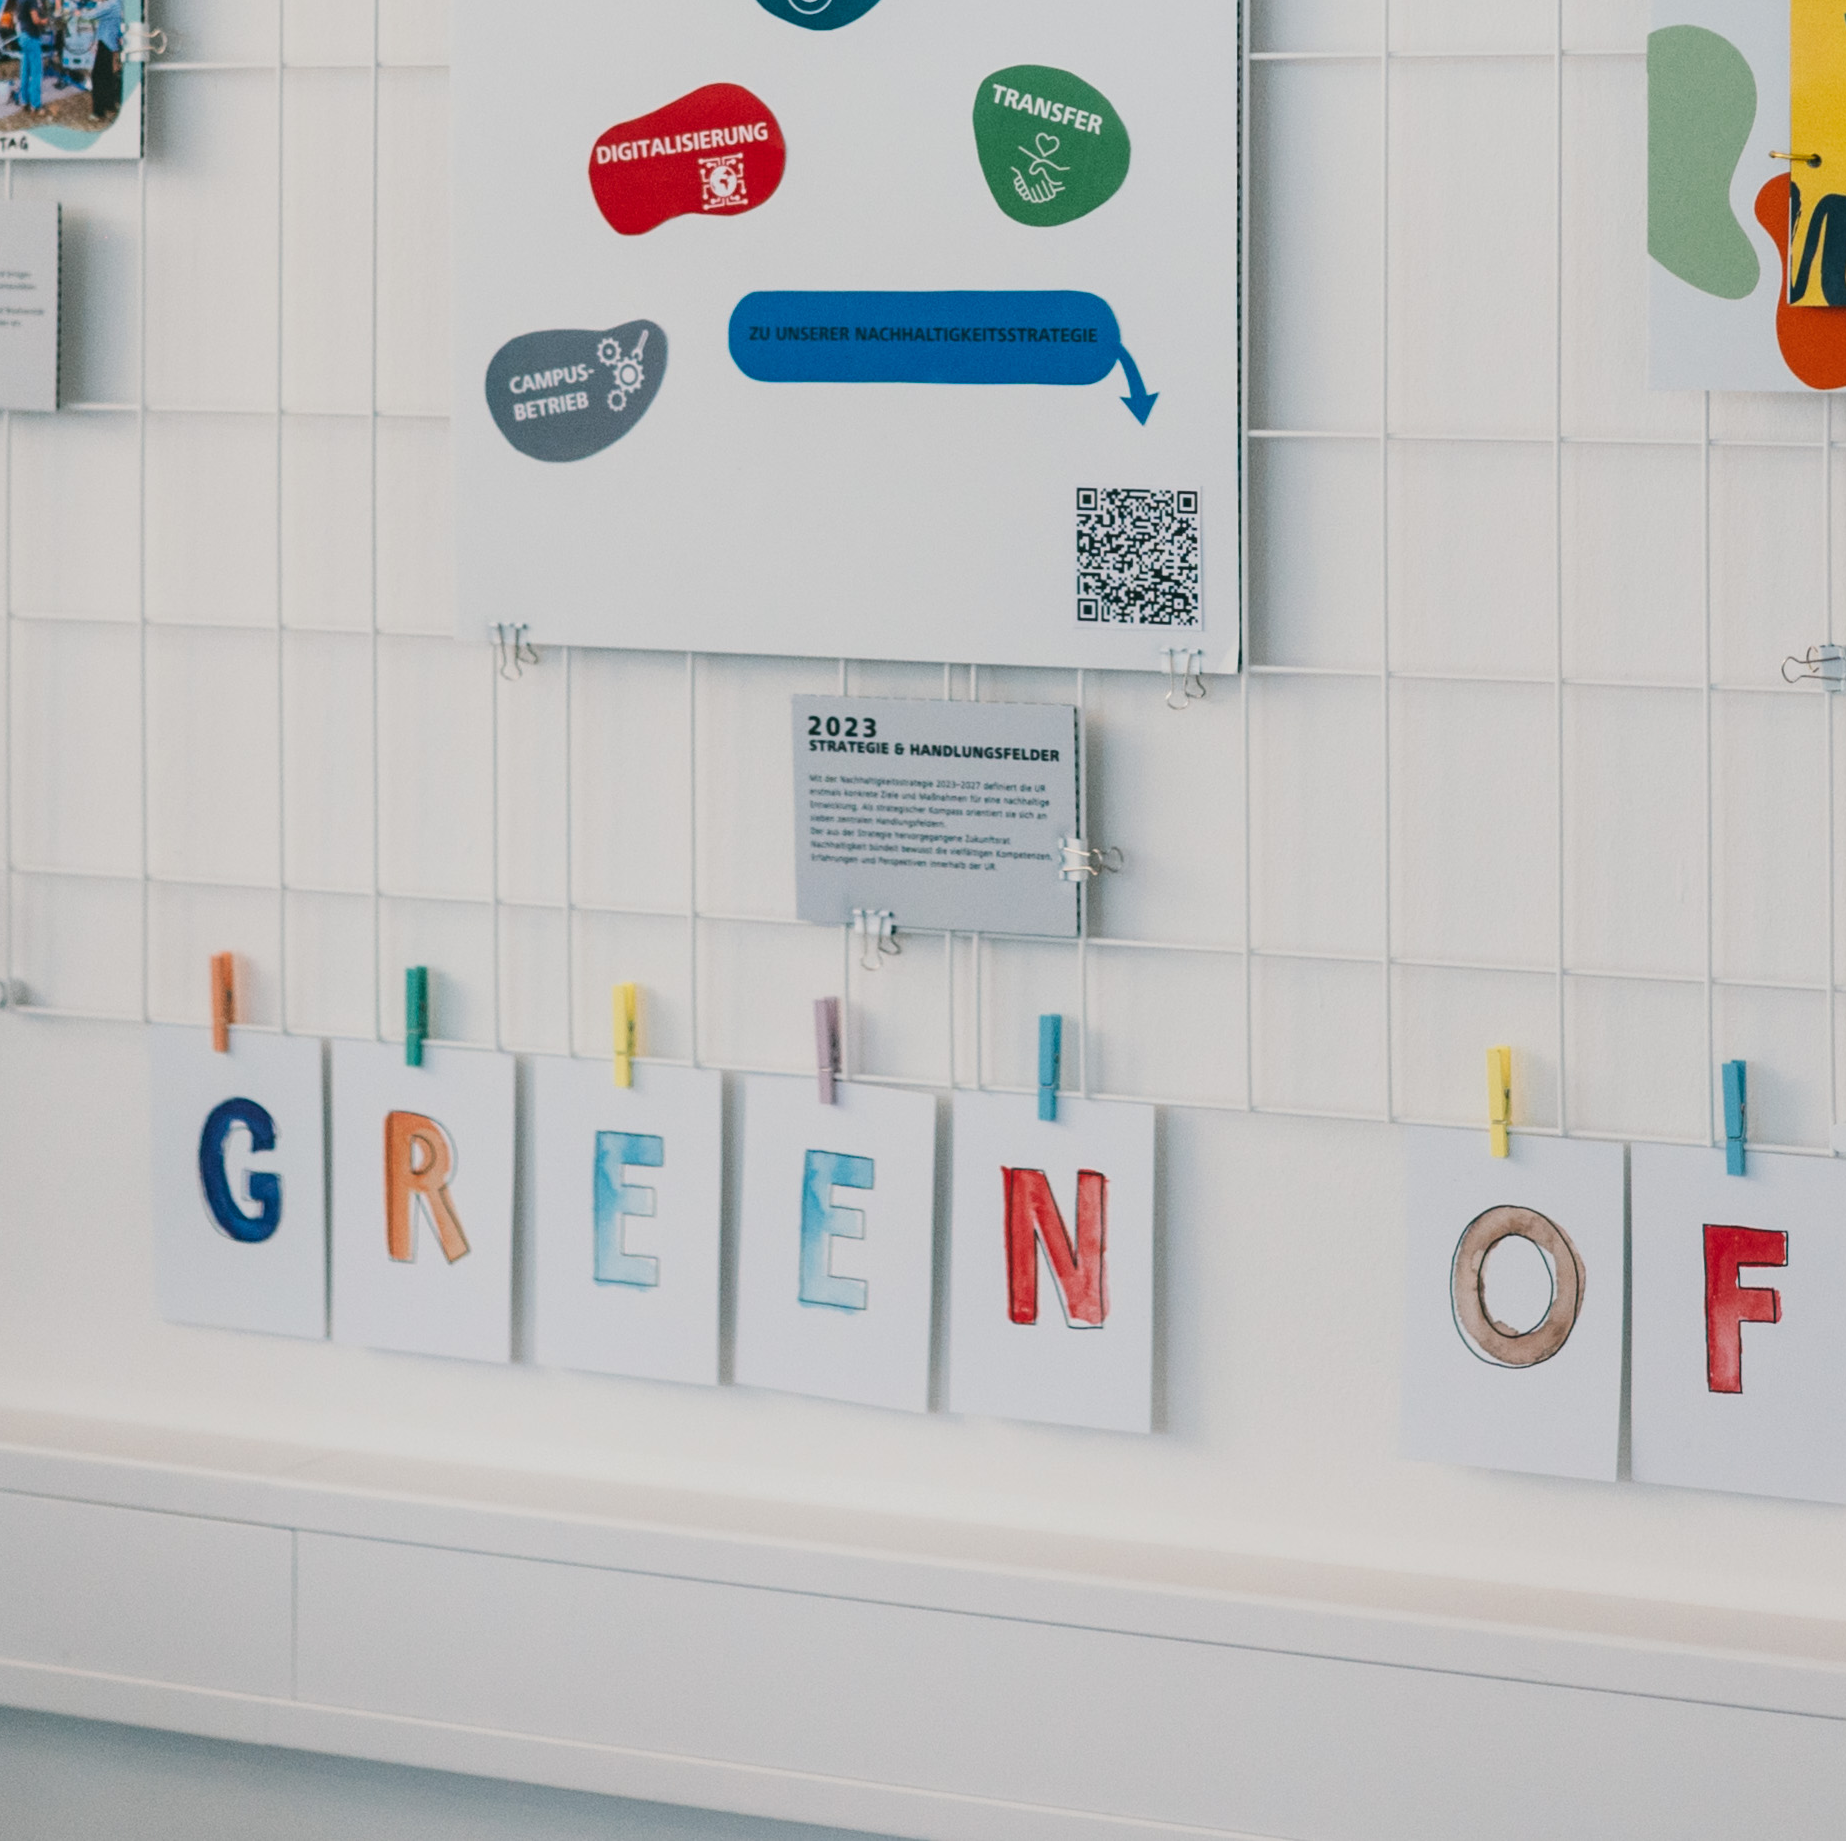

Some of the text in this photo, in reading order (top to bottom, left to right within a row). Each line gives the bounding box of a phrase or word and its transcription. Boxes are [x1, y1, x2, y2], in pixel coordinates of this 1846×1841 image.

[991, 83, 1104, 137] TRANSFER
[595, 120, 770, 166] DIGITALISIERUNG
[747, 325, 1098, 345] ZU UNSERER NACHHALTIGKEITSSTRATEGIE
[508, 362, 595, 395] CAMPUS-
[512, 390, 590, 422] BETRIEB
[807, 715, 878, 738] 2023
[808, 739, 1061, 762] STRATEGIE & HANDLUNGSFELDER
